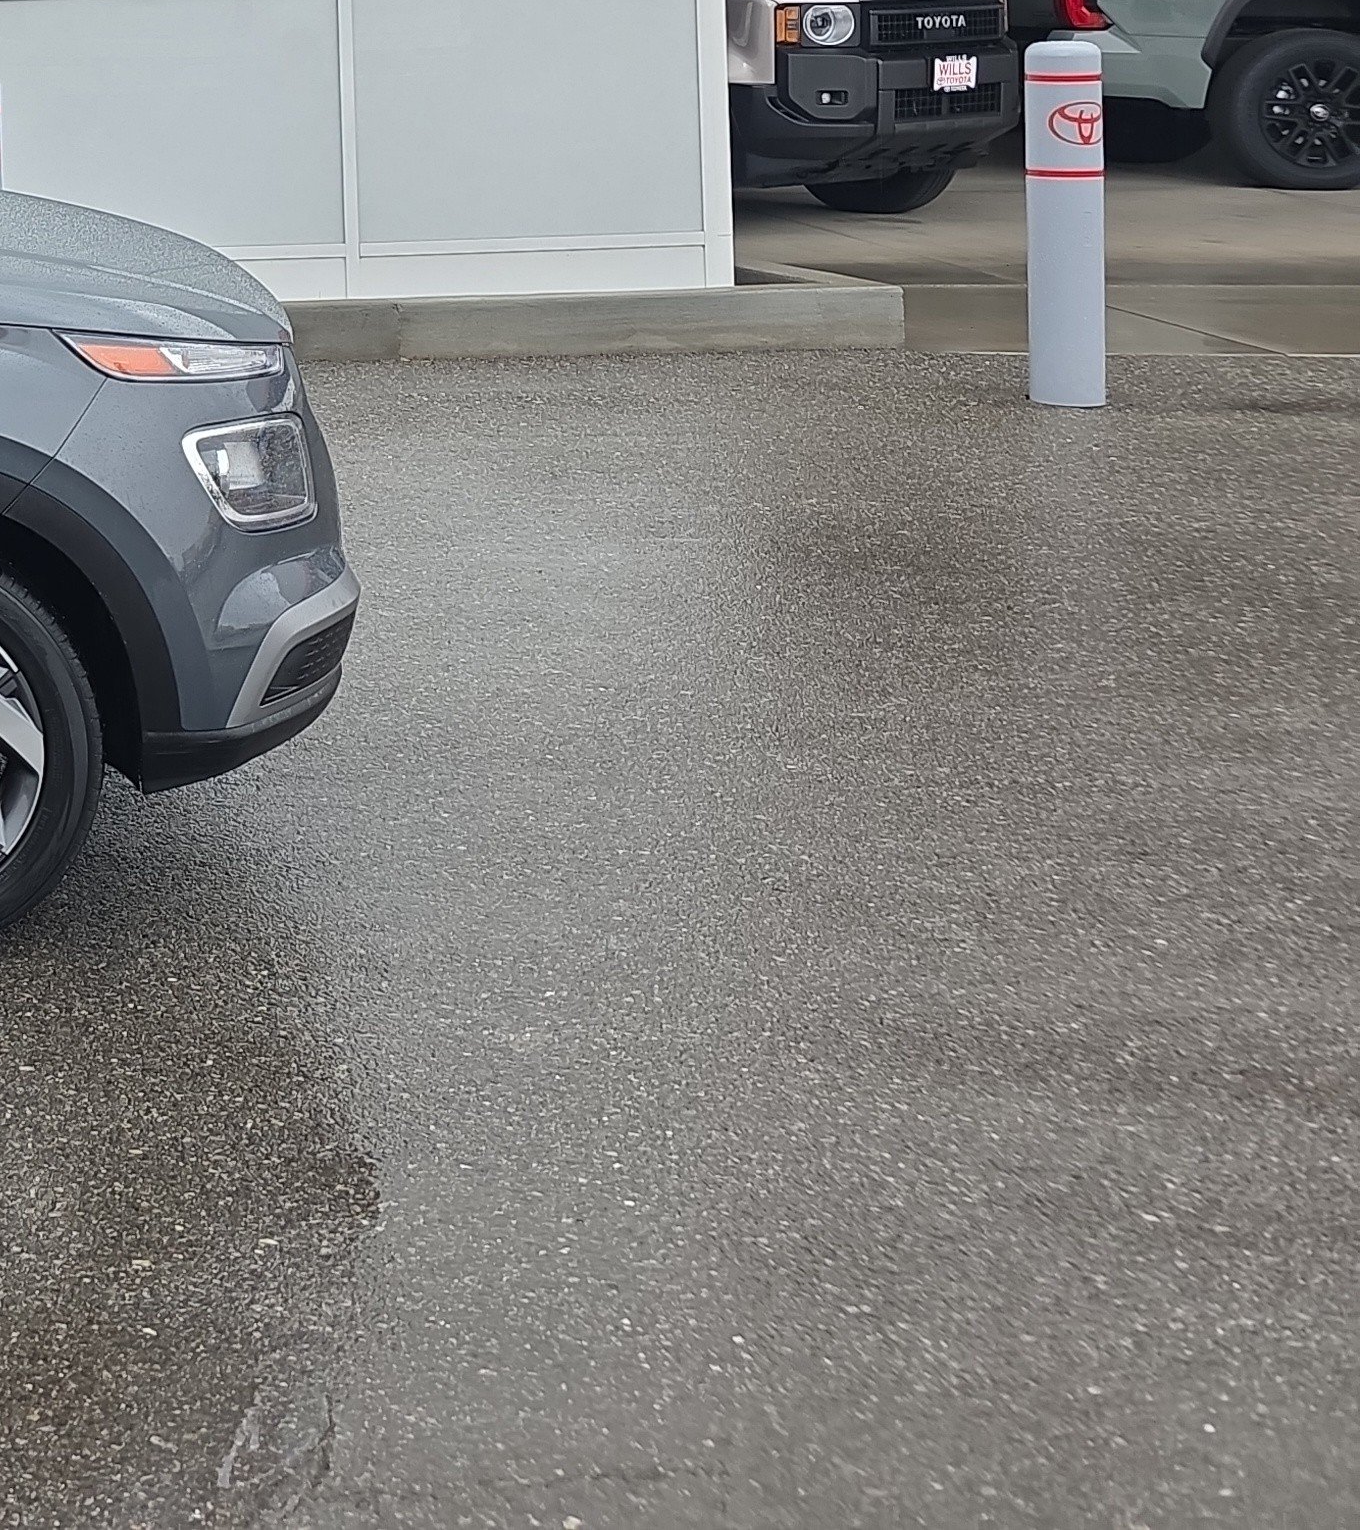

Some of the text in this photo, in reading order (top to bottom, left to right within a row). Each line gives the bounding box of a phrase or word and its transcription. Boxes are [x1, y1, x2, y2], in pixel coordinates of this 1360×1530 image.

[916, 15, 967, 30] TOYOTA
[939, 62, 972, 76] WILLS
[946, 76, 972, 84] TOYOTA
